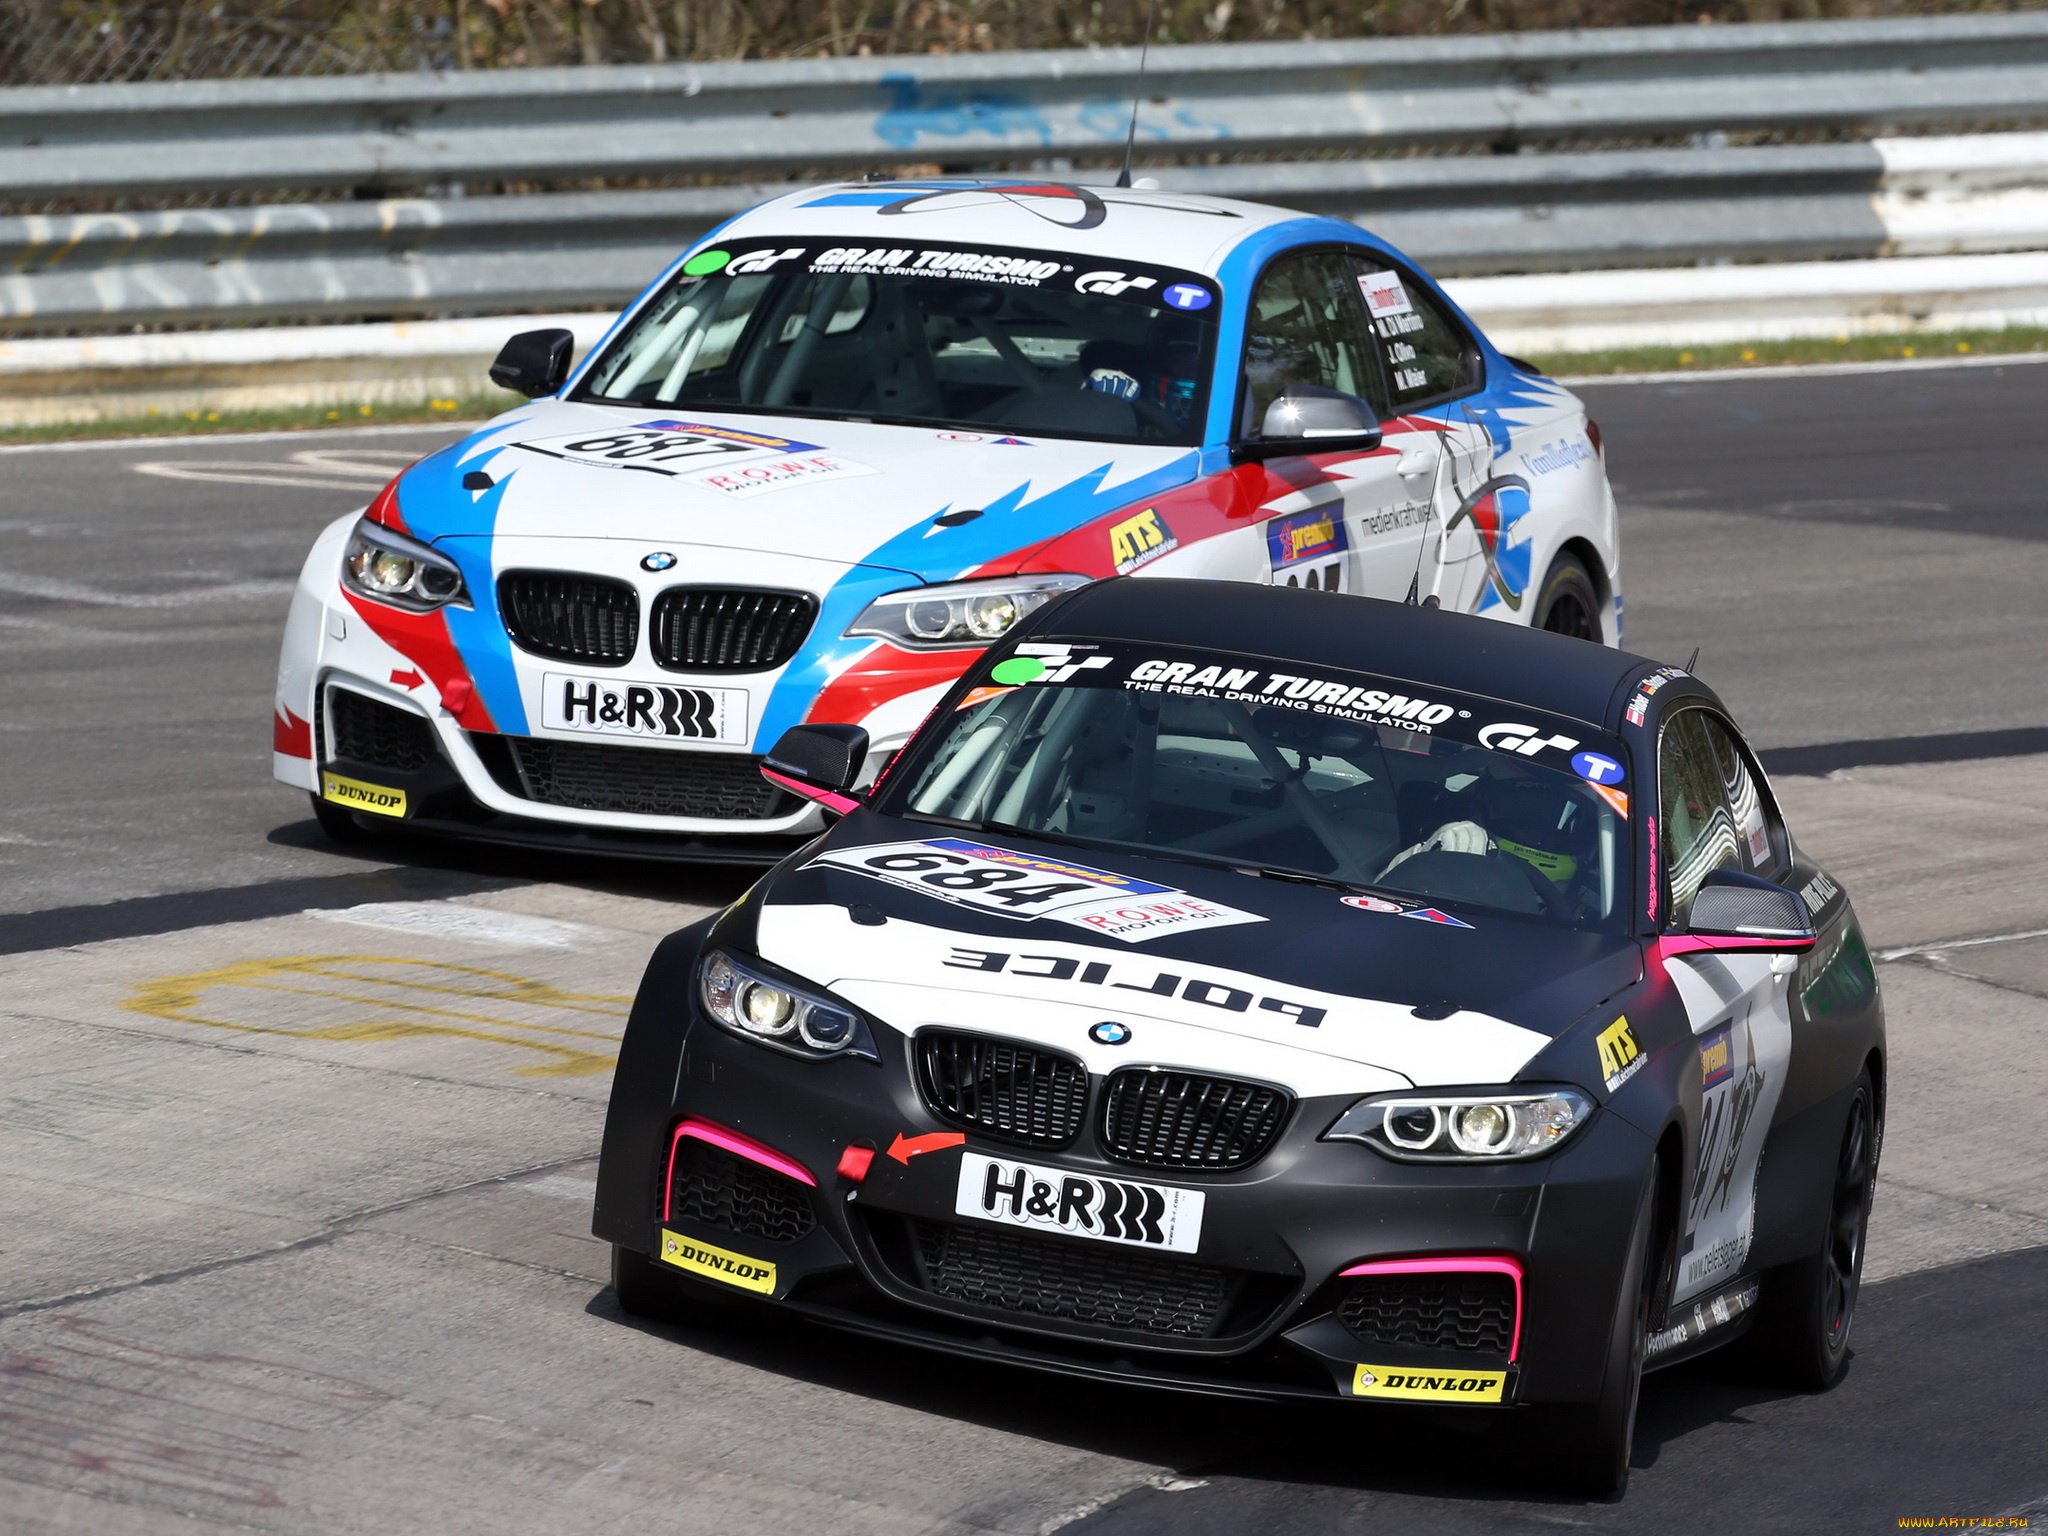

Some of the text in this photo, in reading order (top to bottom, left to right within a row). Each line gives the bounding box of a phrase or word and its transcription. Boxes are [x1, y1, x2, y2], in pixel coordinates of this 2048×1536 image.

[808, 264, 1040, 287] THE REAL DRIVING SIMULATOR
[814, 248, 1061, 280] GRAN TURISMO
[1173, 284, 1205, 308] T
[563, 432, 760, 462] 687
[707, 457, 839, 488] ROWE
[725, 466, 848, 492] MOTOR OIL
[1108, 510, 1164, 567] ATS
[563, 678, 660, 735] H&R
[1123, 680, 1433, 735] THE REAL DRIVING SIMULATOR
[1130, 660, 1454, 725] GRAN TURISMO
[1584, 754, 1617, 780] T
[338, 785, 401, 808] DUNLOP
[864, 853, 1097, 907] 684
[1082, 900, 1216, 929] ROWE
[1109, 911, 1228, 934] MOTOR OIL
[1596, 1014, 1638, 1082] ATS
[983, 1162, 1097, 1234] H&R
[680, 1244, 770, 1282] DUNLOP
[1383, 1374, 1498, 1392] DUNLOP
